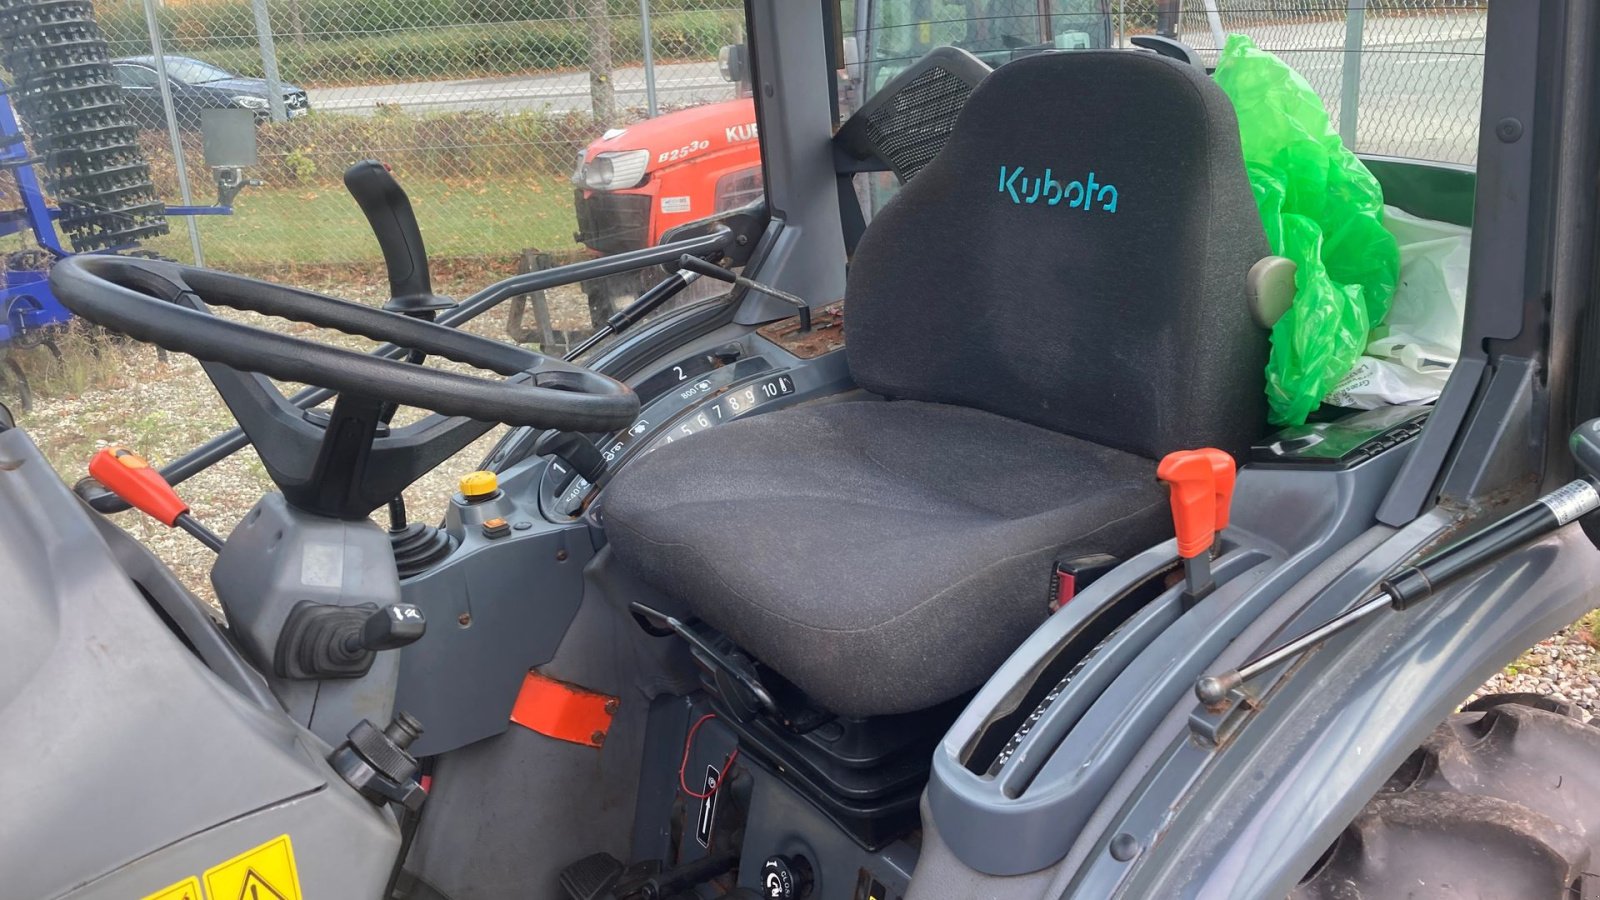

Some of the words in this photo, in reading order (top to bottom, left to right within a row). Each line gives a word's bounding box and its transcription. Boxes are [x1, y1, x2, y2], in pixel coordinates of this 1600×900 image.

[658, 140, 709, 162] B2530
[999, 166, 1118, 213] Kubota
[673, 366, 687, 380] 2
[681, 424, 692, 435] 5
[698, 414, 708, 427] 6
[712, 405, 722, 419] 7
[729, 397, 740, 411] 8
[745, 390, 755, 404] 9
[762, 382, 777, 397] 10
[553, 463, 566, 473] 1
